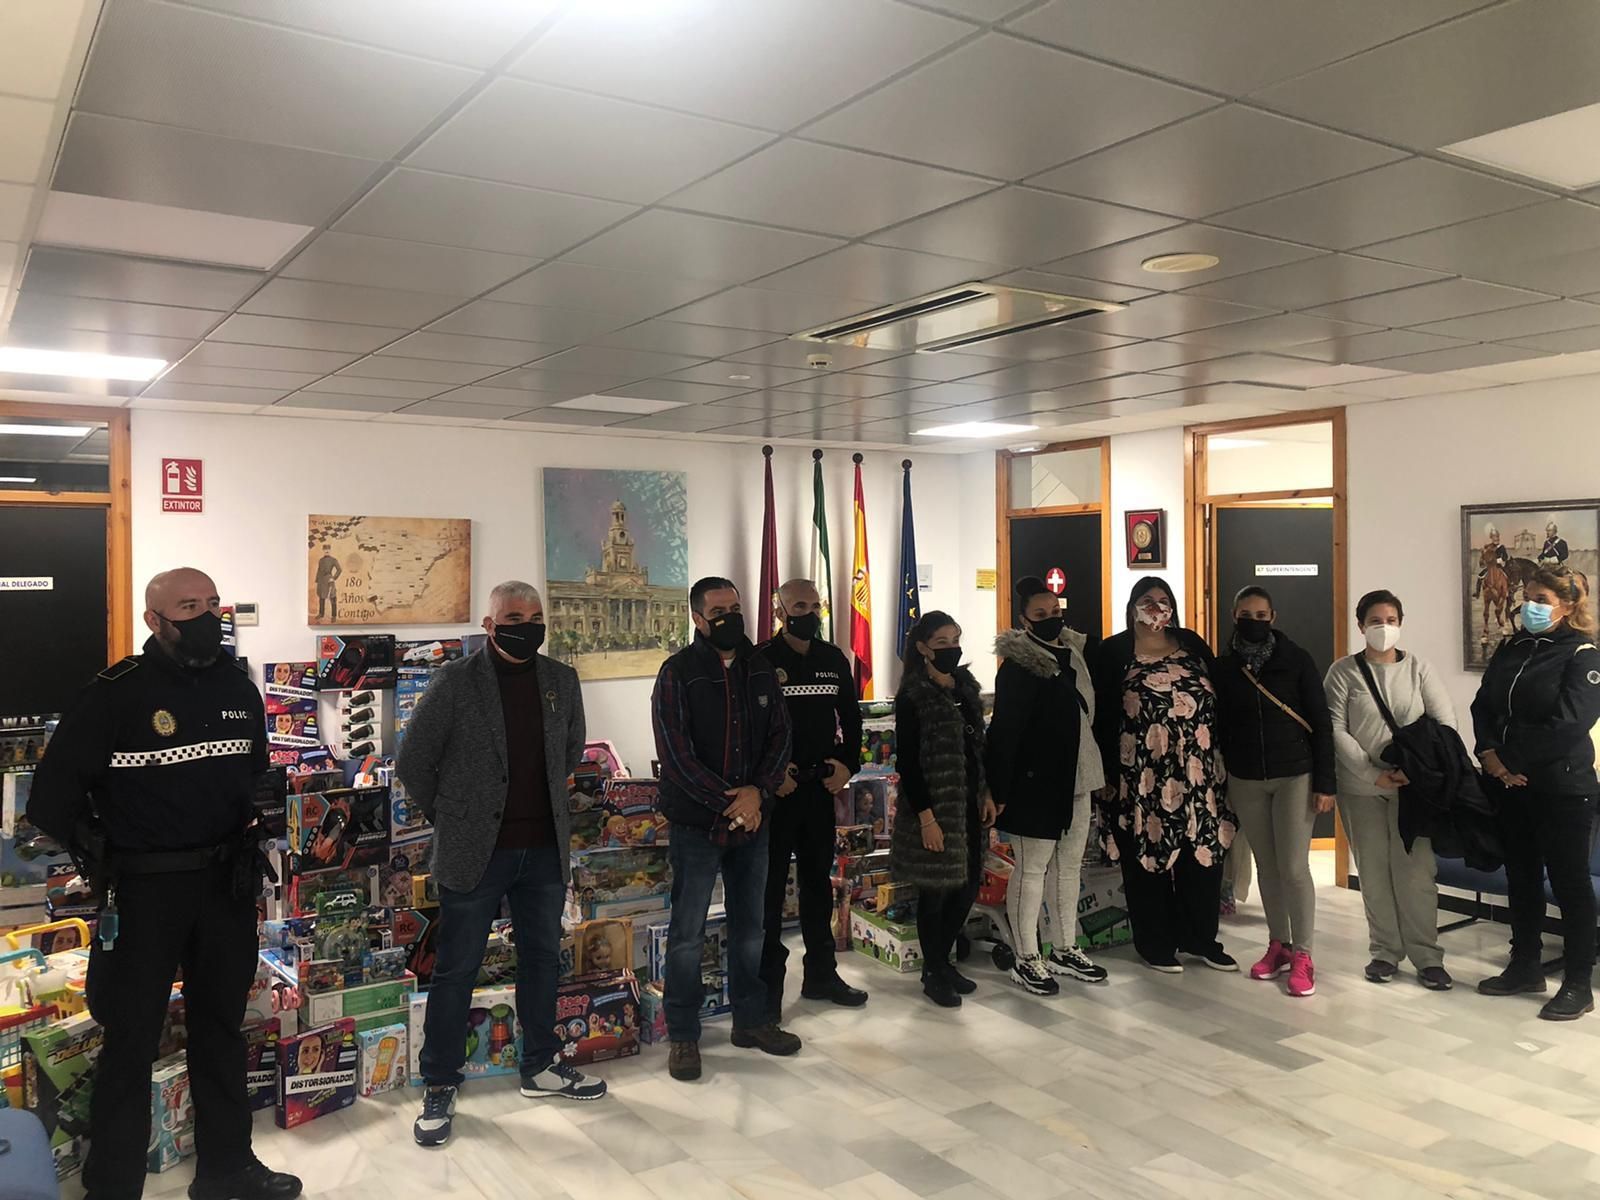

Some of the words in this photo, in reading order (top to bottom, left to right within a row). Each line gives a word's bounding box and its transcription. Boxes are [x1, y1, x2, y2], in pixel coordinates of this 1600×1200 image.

[163, 500, 201, 511] EXTINTOR
[11, 580, 49, 588] DELEGADO
[345, 577, 362, 588] 180
[338, 592, 364, 604] Años
[338, 609, 376, 621] Contigo
[290, 1073, 355, 1090] DISTORSIONADOR
